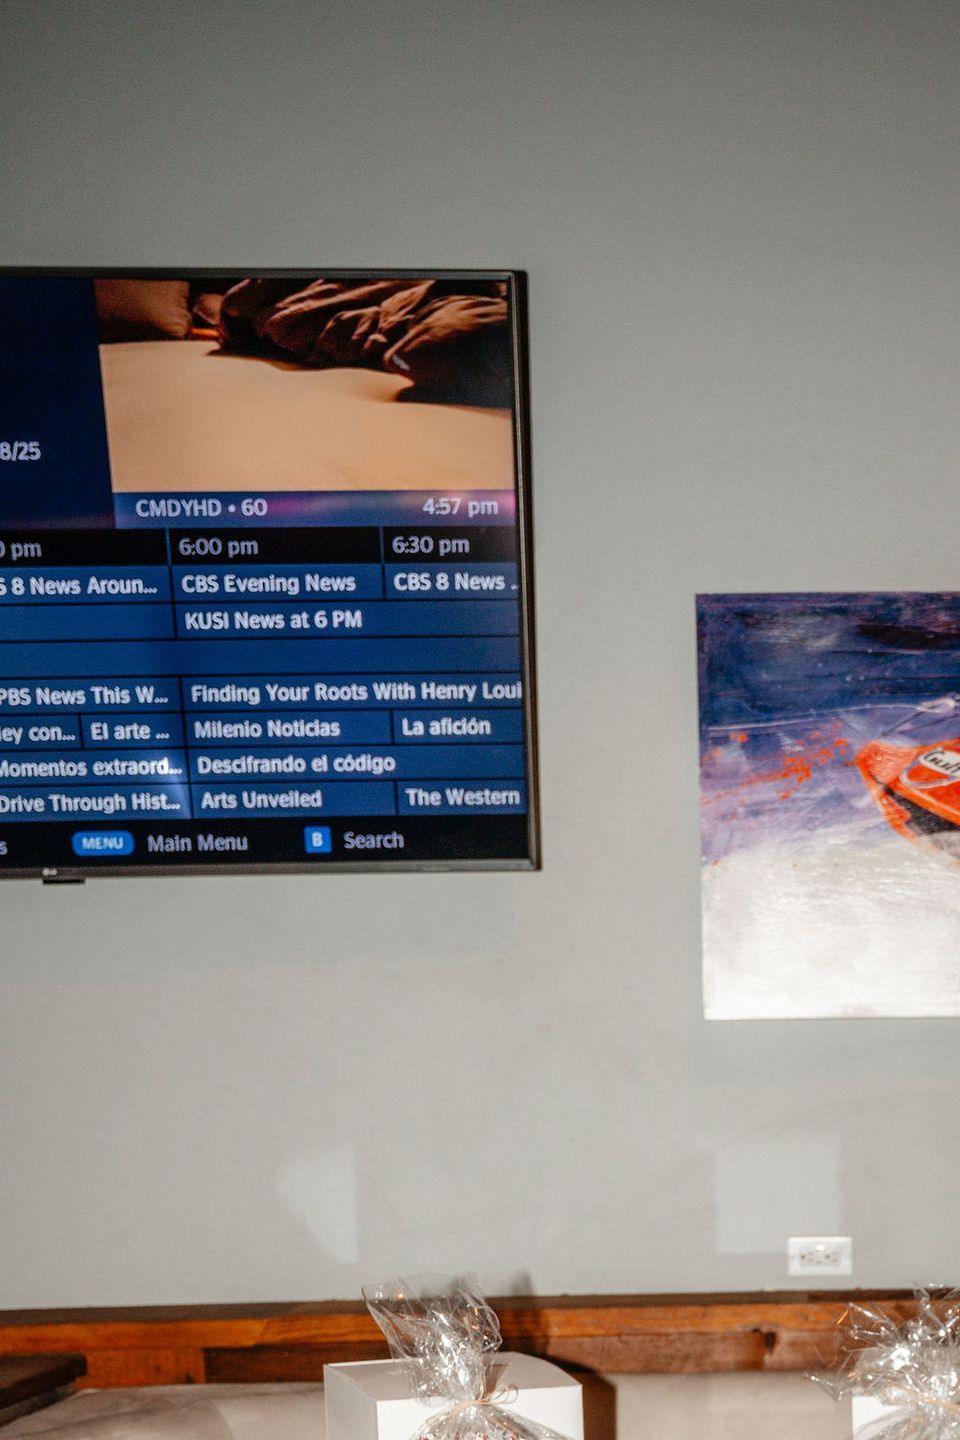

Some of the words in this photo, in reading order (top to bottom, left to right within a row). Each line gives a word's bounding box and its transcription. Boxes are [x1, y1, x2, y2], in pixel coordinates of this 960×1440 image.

[135, 498, 222, 517] CMDYHD
[240, 498, 268, 517] 60
[422, 497, 460, 516] 4:57
[467, 499, 499, 518] pm
[10, 542, 42, 561] pm
[178, 537, 222, 556] 6:00
[227, 539, 259, 558] pm
[391, 536, 434, 554] 6:30
[439, 537, 470, 557] pm
[11, 576, 25, 596] 8
[29, 577, 82, 596] News
[181, 574, 219, 594] CBS
[224, 572, 300, 595] Evening
[304, 572, 357, 592] News
[393, 572, 431, 591] CBS
[434, 572, 450, 591] 8
[454, 572, 505, 591] News
[184, 611, 230, 631] KUSI
[233, 610, 286, 630] News
[290, 611, 311, 629] at
[313, 610, 328, 629] 6
[332, 609, 362, 629] PM
[35, 686, 86, 706] News
[90, 685, 131, 705] This
[190, 684, 260, 706] Finding
[264, 682, 310, 702] Your
[314, 682, 368, 702] Roots
[372, 681, 416, 702] With
[420, 681, 477, 703] Henry
[482, 680, 523, 701] Loui
[89, 722, 109, 741] El
[113, 723, 151, 741] arte
[193, 720, 262, 740] Milenio
[266, 718, 341, 738] Noticias
[401, 717, 424, 736] La
[429, 716, 491, 736] afición
[196, 755, 307, 775] Descifrando
[310, 754, 328, 773] el
[332, 753, 396, 776] código
[48, 792, 128, 815] Through
[200, 791, 238, 810] Arts
[241, 789, 323, 809] Unveiled
[405, 787, 441, 807] The
[445, 787, 521, 807] Western
[81, 836, 125, 851] MENU
[147, 835, 193, 853] Main
[197, 834, 249, 852] Menu
[311, 831, 324, 847] B
[342, 831, 405, 850] Search
